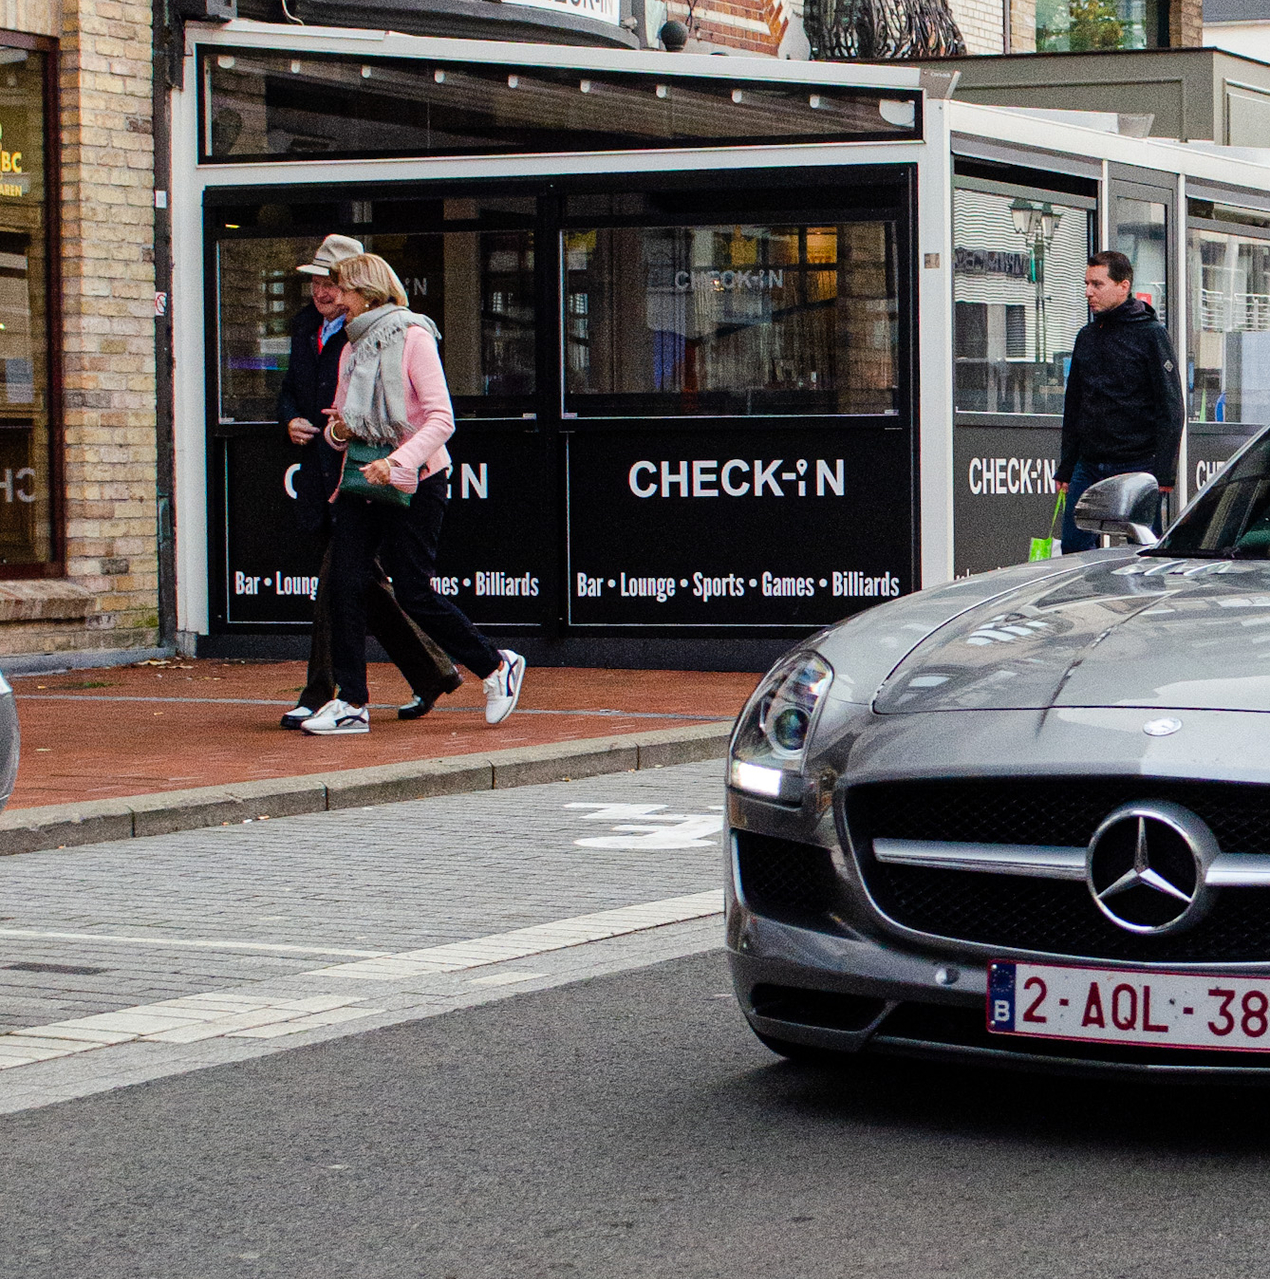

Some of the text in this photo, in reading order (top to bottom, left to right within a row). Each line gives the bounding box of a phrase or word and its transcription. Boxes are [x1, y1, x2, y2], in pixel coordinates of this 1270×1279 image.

[628, 458, 846, 499] CHECK-IN
[968, 457, 1057, 495] CHECK-IN
[235, 570, 261, 596] Bar
[275, 570, 320, 602] Loung
[475, 571, 540, 597] Billiards
[577, 571, 900, 603] Bar Lounge Sports Games Billiards
[994, 999, 1011, 1022] B
